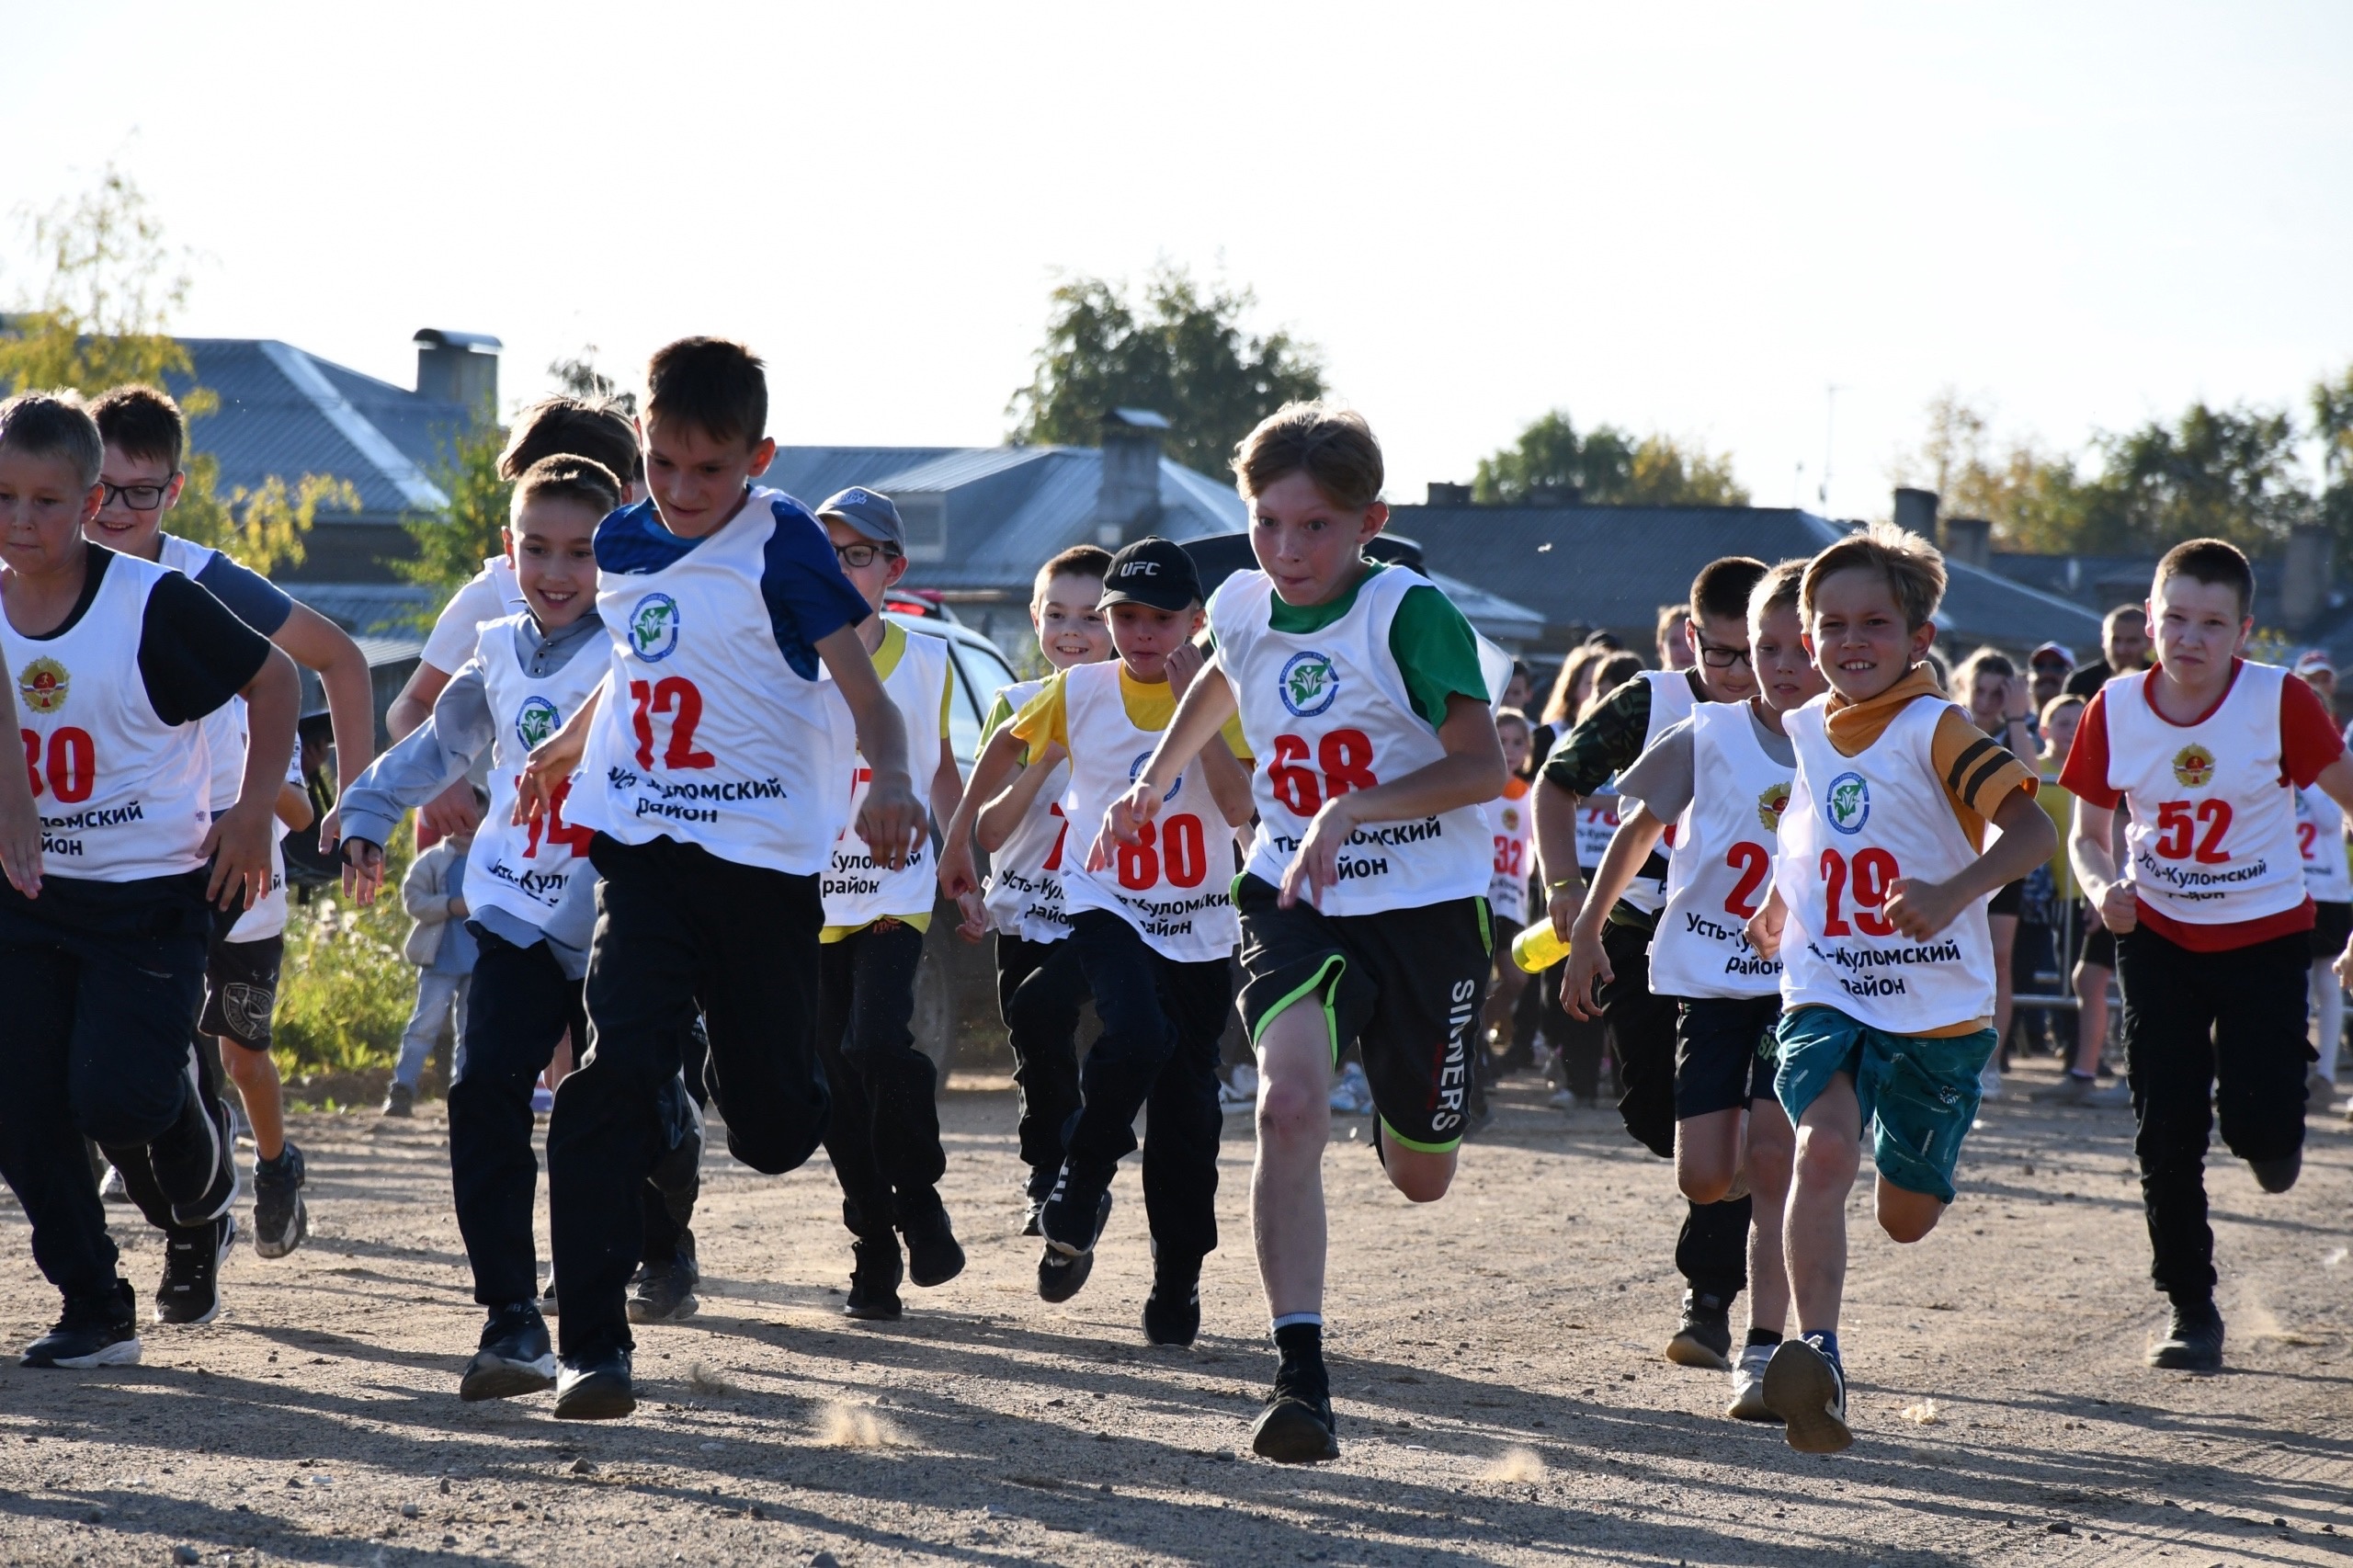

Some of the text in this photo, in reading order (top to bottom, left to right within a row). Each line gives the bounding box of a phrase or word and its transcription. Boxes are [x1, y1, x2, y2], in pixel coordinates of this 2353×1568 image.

[1120, 561, 1161, 577] UFC
[629, 676, 716, 772] 12
[1267, 729, 1380, 817] 68
[41, 832, 83, 856] йон
[1118, 813, 1207, 891] 80
[1494, 835, 1523, 878] 32
[2155, 798, 2233, 864] 52
[823, 876, 881, 898] район
[1336, 856, 1389, 881] йон
[1820, 847, 1901, 937] 29
[1432, 978, 1475, 1131] SINNERS
